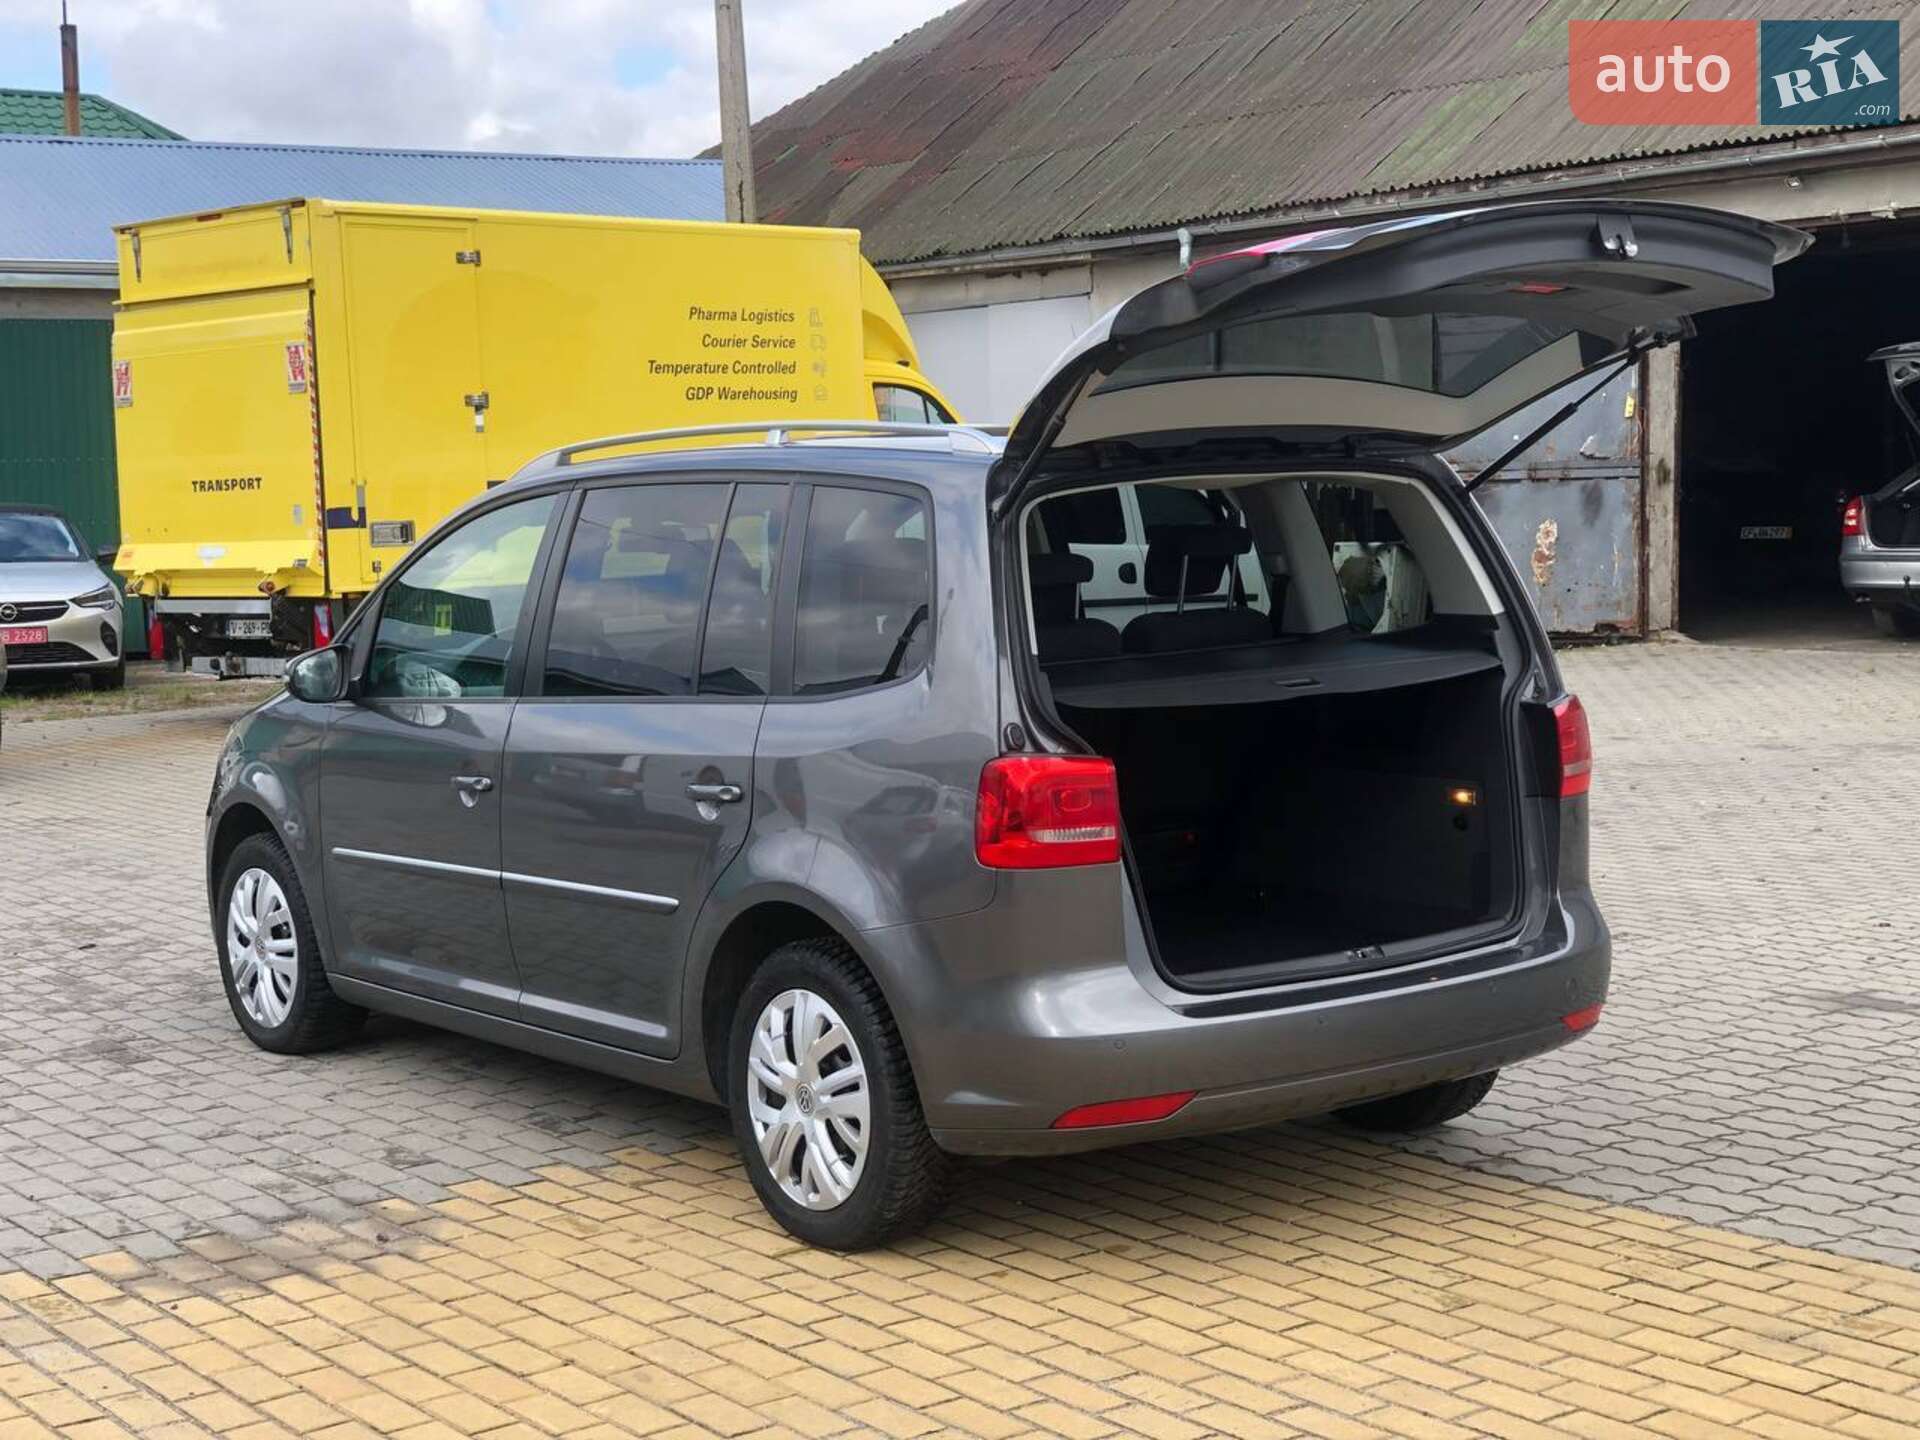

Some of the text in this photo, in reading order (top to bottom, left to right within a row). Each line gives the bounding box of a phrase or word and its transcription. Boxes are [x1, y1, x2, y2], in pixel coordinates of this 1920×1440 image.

[688, 306, 795, 325] Pharma Logistics
[702, 333, 796, 349] Courier Service
[648, 360, 797, 376] Temperature Controlled
[685, 386, 798, 403] GDP Warehousing
[191, 477, 262, 493] TRANSPORT
[15, 630, 42, 642] 2528
